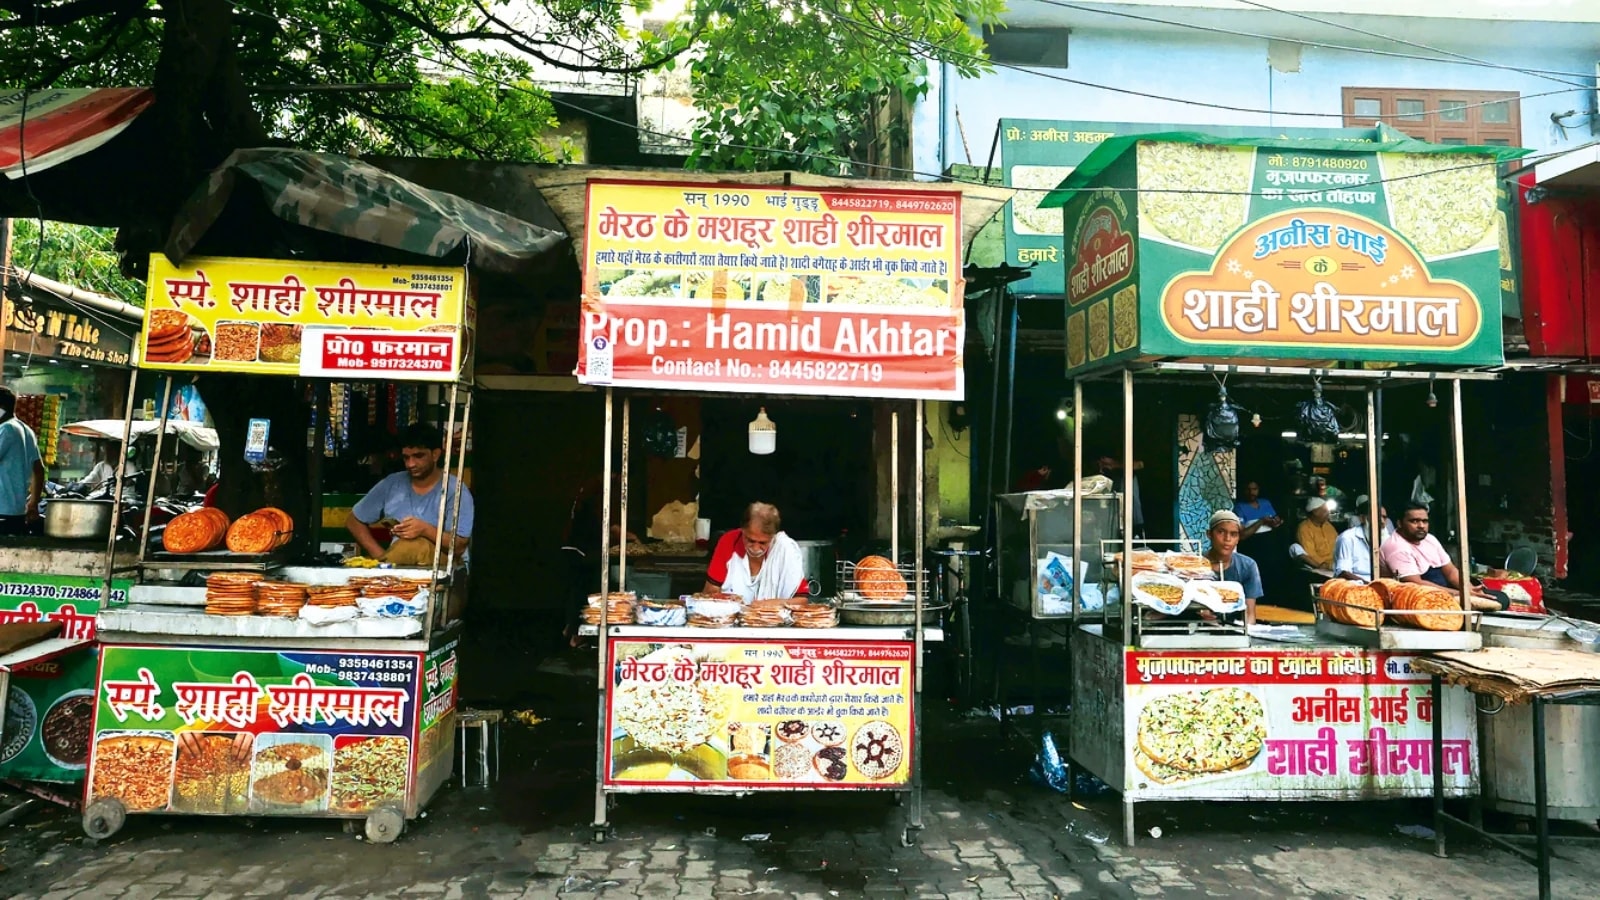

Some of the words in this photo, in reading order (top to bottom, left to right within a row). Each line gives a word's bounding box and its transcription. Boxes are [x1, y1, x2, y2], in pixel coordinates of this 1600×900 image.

[1292, 157, 1367, 170] 8791480920
[684, 192, 708, 209] सन्
[714, 194, 750, 207] 1990
[766, 192, 787, 208] भाई
[1260, 188, 1283, 200] का
[895, 200, 954, 211] 8449762620
[599, 207, 656, 238] मेरठ
[664, 209, 690, 238] के
[697, 217, 775, 249] मशहूर
[783, 213, 838, 245] शाही
[846, 214, 944, 248] शीरमाल
[1254, 219, 1330, 259] अनीस
[1336, 226, 1388, 265] भाई
[595, 249, 615, 265] हमारे
[635, 250, 651, 263] मेरठ
[653, 251, 662, 264] के
[740, 253, 758, 268] किये
[760, 255, 777, 268] जाते
[791, 255, 810, 270] शादी
[839, 257, 847, 270] के
[873, 257, 883, 271] भी
[900, 258, 918, 273] किये
[920, 260, 937, 274] जाते
[1017, 246, 1058, 263] हमारे
[1314, 257, 1329, 273] के
[165, 270, 215, 307] स्पे.
[228, 275, 307, 316] शाही
[315, 278, 442, 318] शीरमाल
[1183, 280, 1280, 334] शाही
[1289, 282, 1460, 337] शीरमाल
[65, 313, 100, 344] Take
[584, 312, 690, 357] Prop.:
[706, 313, 821, 354] Hamid
[833, 317, 950, 357] Akhtar
[60, 341, 82, 357] The
[83, 346, 105, 361] Cake
[372, 341, 450, 357] फरमान
[337, 357, 368, 368] Mob-
[370, 359, 443, 369] 9917324370
[651, 355, 721, 378] Contact
[769, 360, 883, 382] 8445822719
[305, 663, 337, 674] Mob-
[339, 658, 414, 670] 9359461354
[621, 656, 668, 682] मेरठ
[673, 657, 695, 682] के
[701, 663, 765, 689] मशहूर
[770, 659, 816, 686] शाही
[822, 659, 901, 686] शीरमाल
[1250, 655, 1273, 675] का
[337, 671, 412, 683] 9837438801
[103, 668, 166, 724] स्पे.
[174, 671, 263, 727] शाही
[266, 672, 410, 728] शीरमाल
[1292, 688, 1361, 723] अनीस
[1369, 688, 1409, 724] भाई
[1264, 727, 1338, 776] शाही
